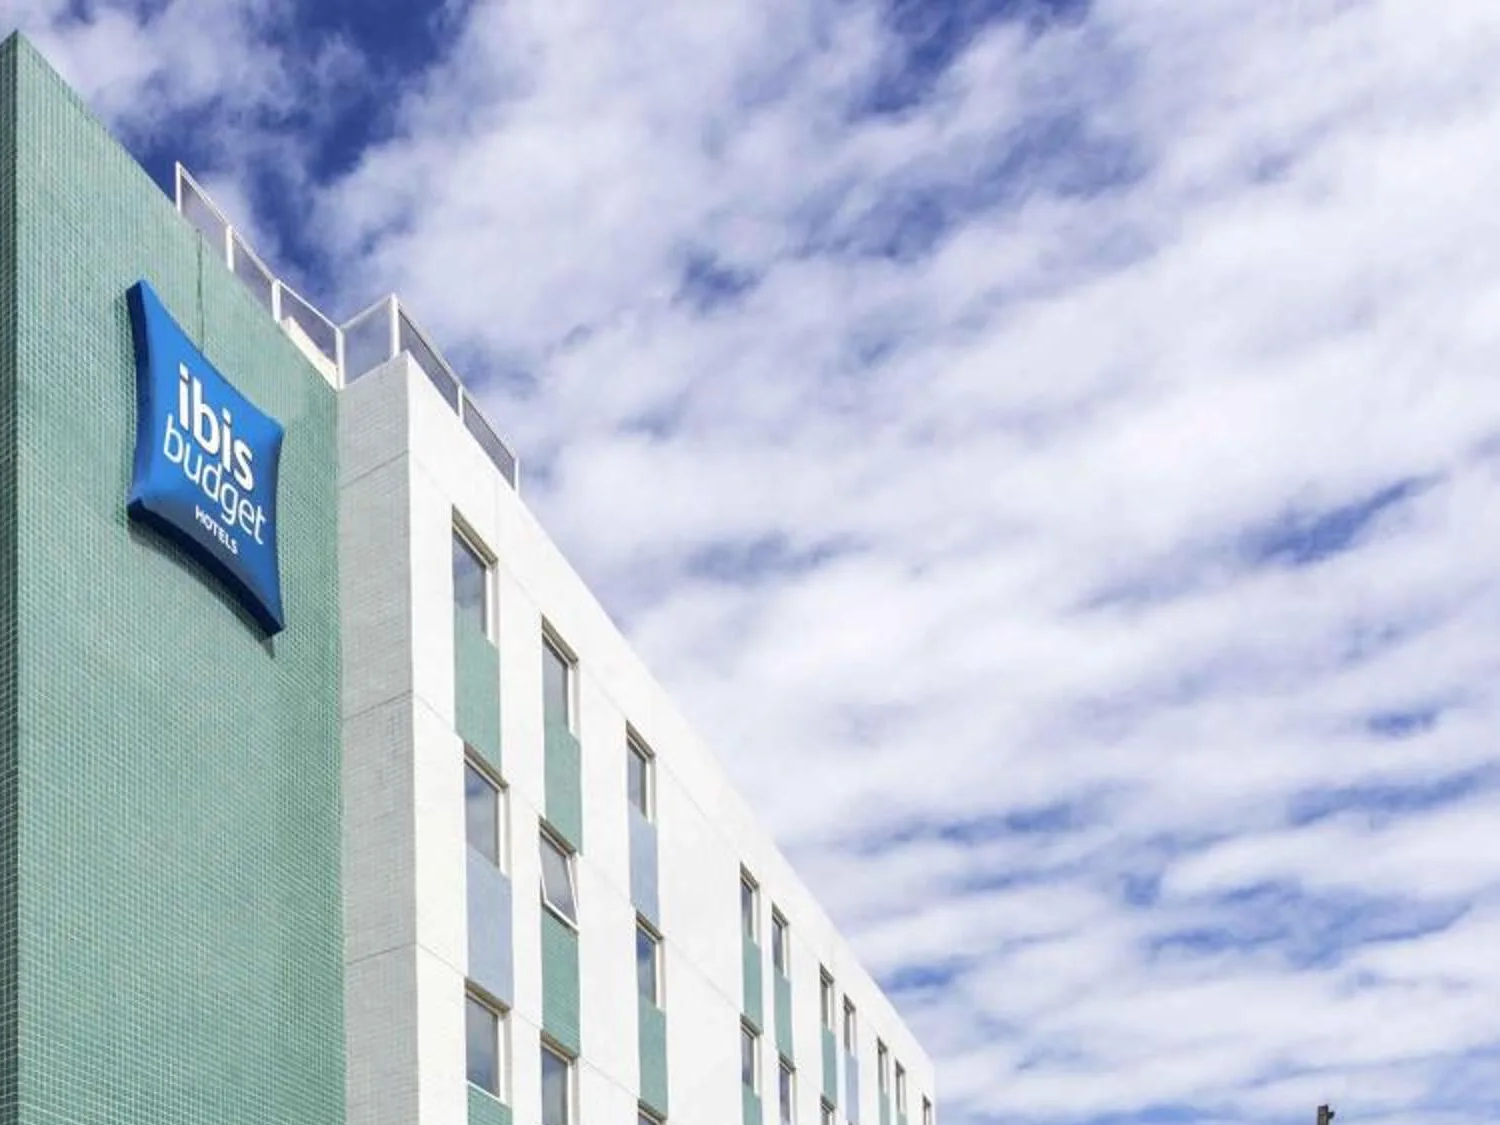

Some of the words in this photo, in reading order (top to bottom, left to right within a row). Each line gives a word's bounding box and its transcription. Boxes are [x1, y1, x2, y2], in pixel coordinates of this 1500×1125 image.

[163, 414, 266, 545] budget
[178, 363, 253, 491] ibis
[195, 505, 238, 555] HOTELS
